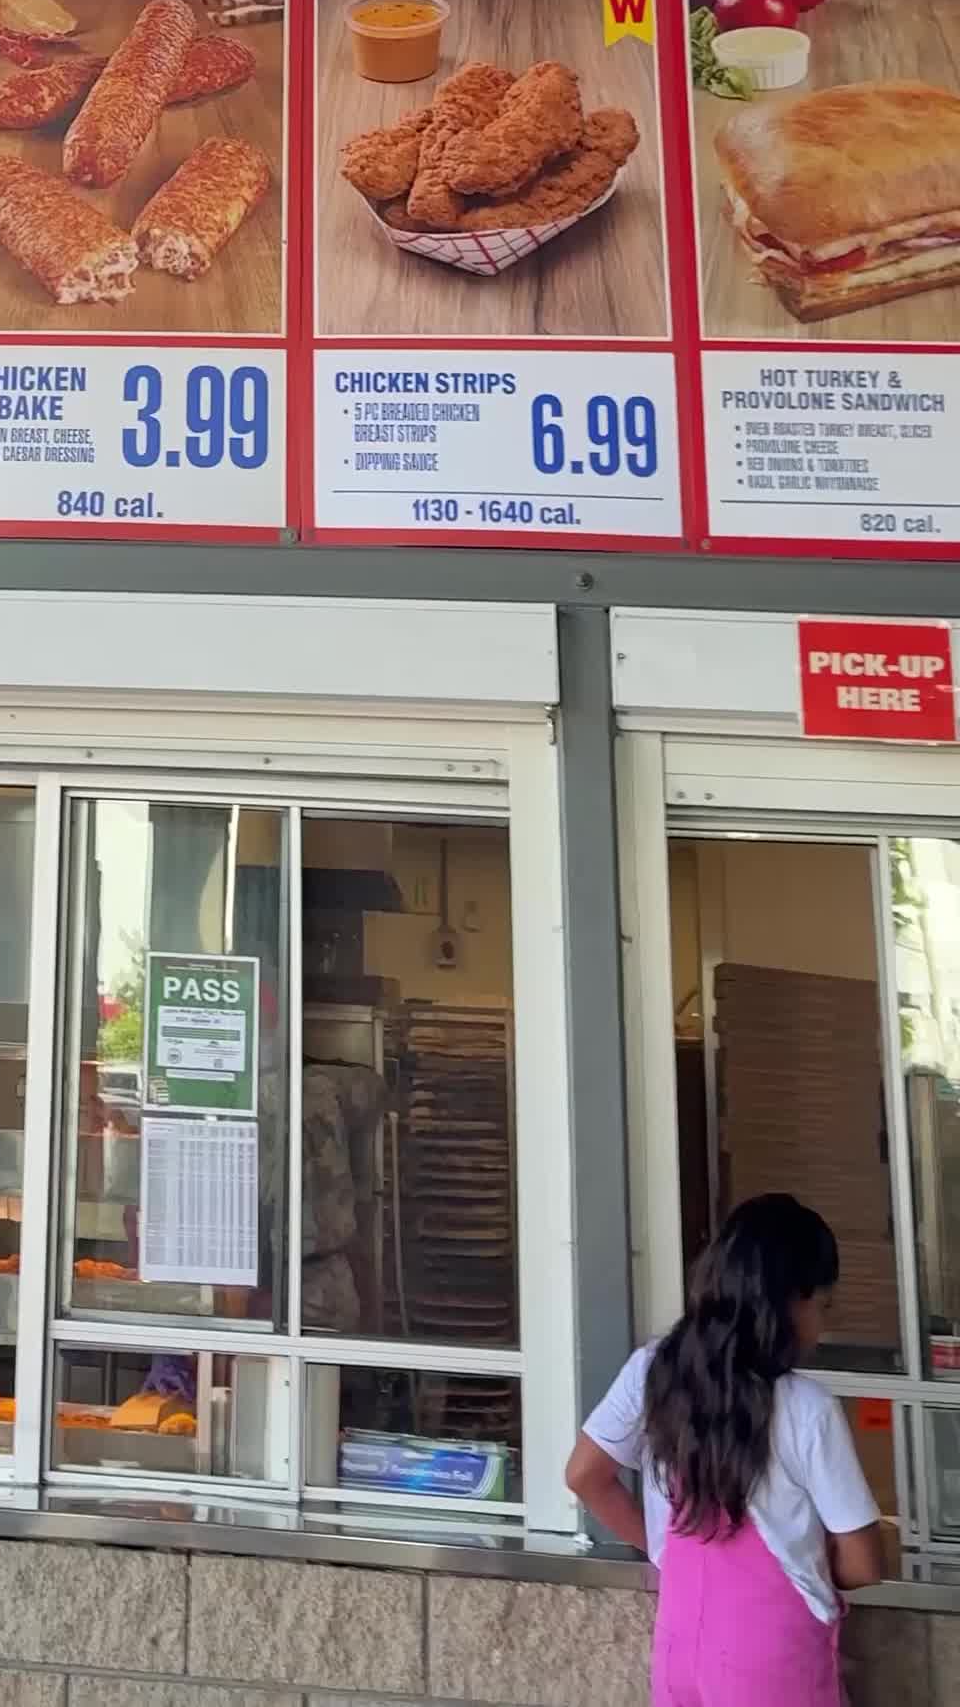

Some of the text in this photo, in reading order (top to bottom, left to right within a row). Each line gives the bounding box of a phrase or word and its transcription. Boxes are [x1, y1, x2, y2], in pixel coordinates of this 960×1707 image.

[335, 371, 516, 394] CHICKEN STRIPS
[760, 369, 902, 389] HOT TURKEY &
[432, 403, 480, 421] CHICKEN
[721, 391, 945, 412] PROVOLONE SANDWICH
[122, 364, 269, 470] 3.99
[354, 424, 437, 442] BREAST STRIPS
[531, 394, 658, 478] 6.99
[2, 446, 41, 463] CAESAR
[44, 446, 95, 464] DRESSING
[57, 491, 164, 518] 840 cal.
[412, 499, 458, 522] 1130
[478, 500, 533, 524] 1640
[540, 503, 581, 525] cal.
[860, 514, 941, 533] 820 cal.
[809, 651, 944, 678] PICK-UP
[837, 686, 921, 712] HERE
[163, 976, 240, 1004] PASS
